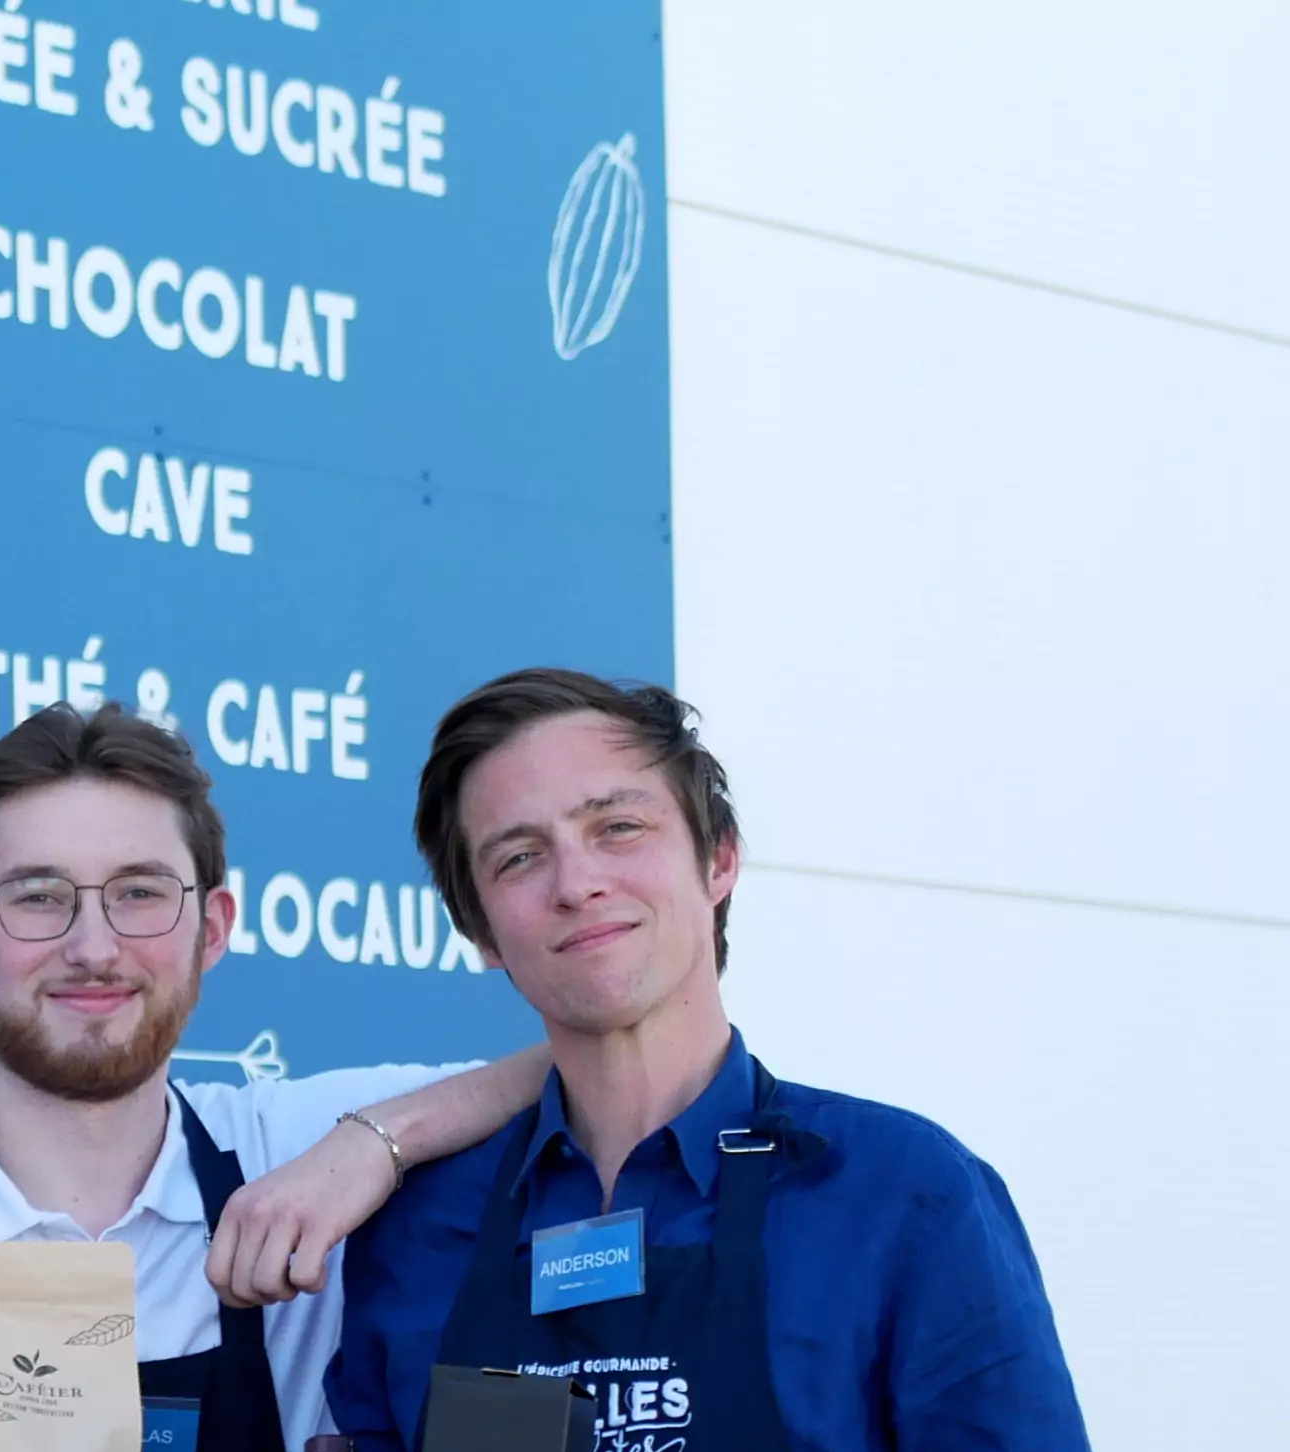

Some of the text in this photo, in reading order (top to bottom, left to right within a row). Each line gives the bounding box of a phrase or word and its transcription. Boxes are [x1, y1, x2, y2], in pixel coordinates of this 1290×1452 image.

[104, 37, 154, 131] &
[180, 57, 446, 197] SUCRÉE
[84, 447, 253, 555] CAVE
[207, 670, 369, 780] CAFÉ
[227, 868, 485, 973] LOCAUX
[540, 1246, 630, 1279] ANDERSON
[583, 1357, 669, 1373] GOURMANDE
